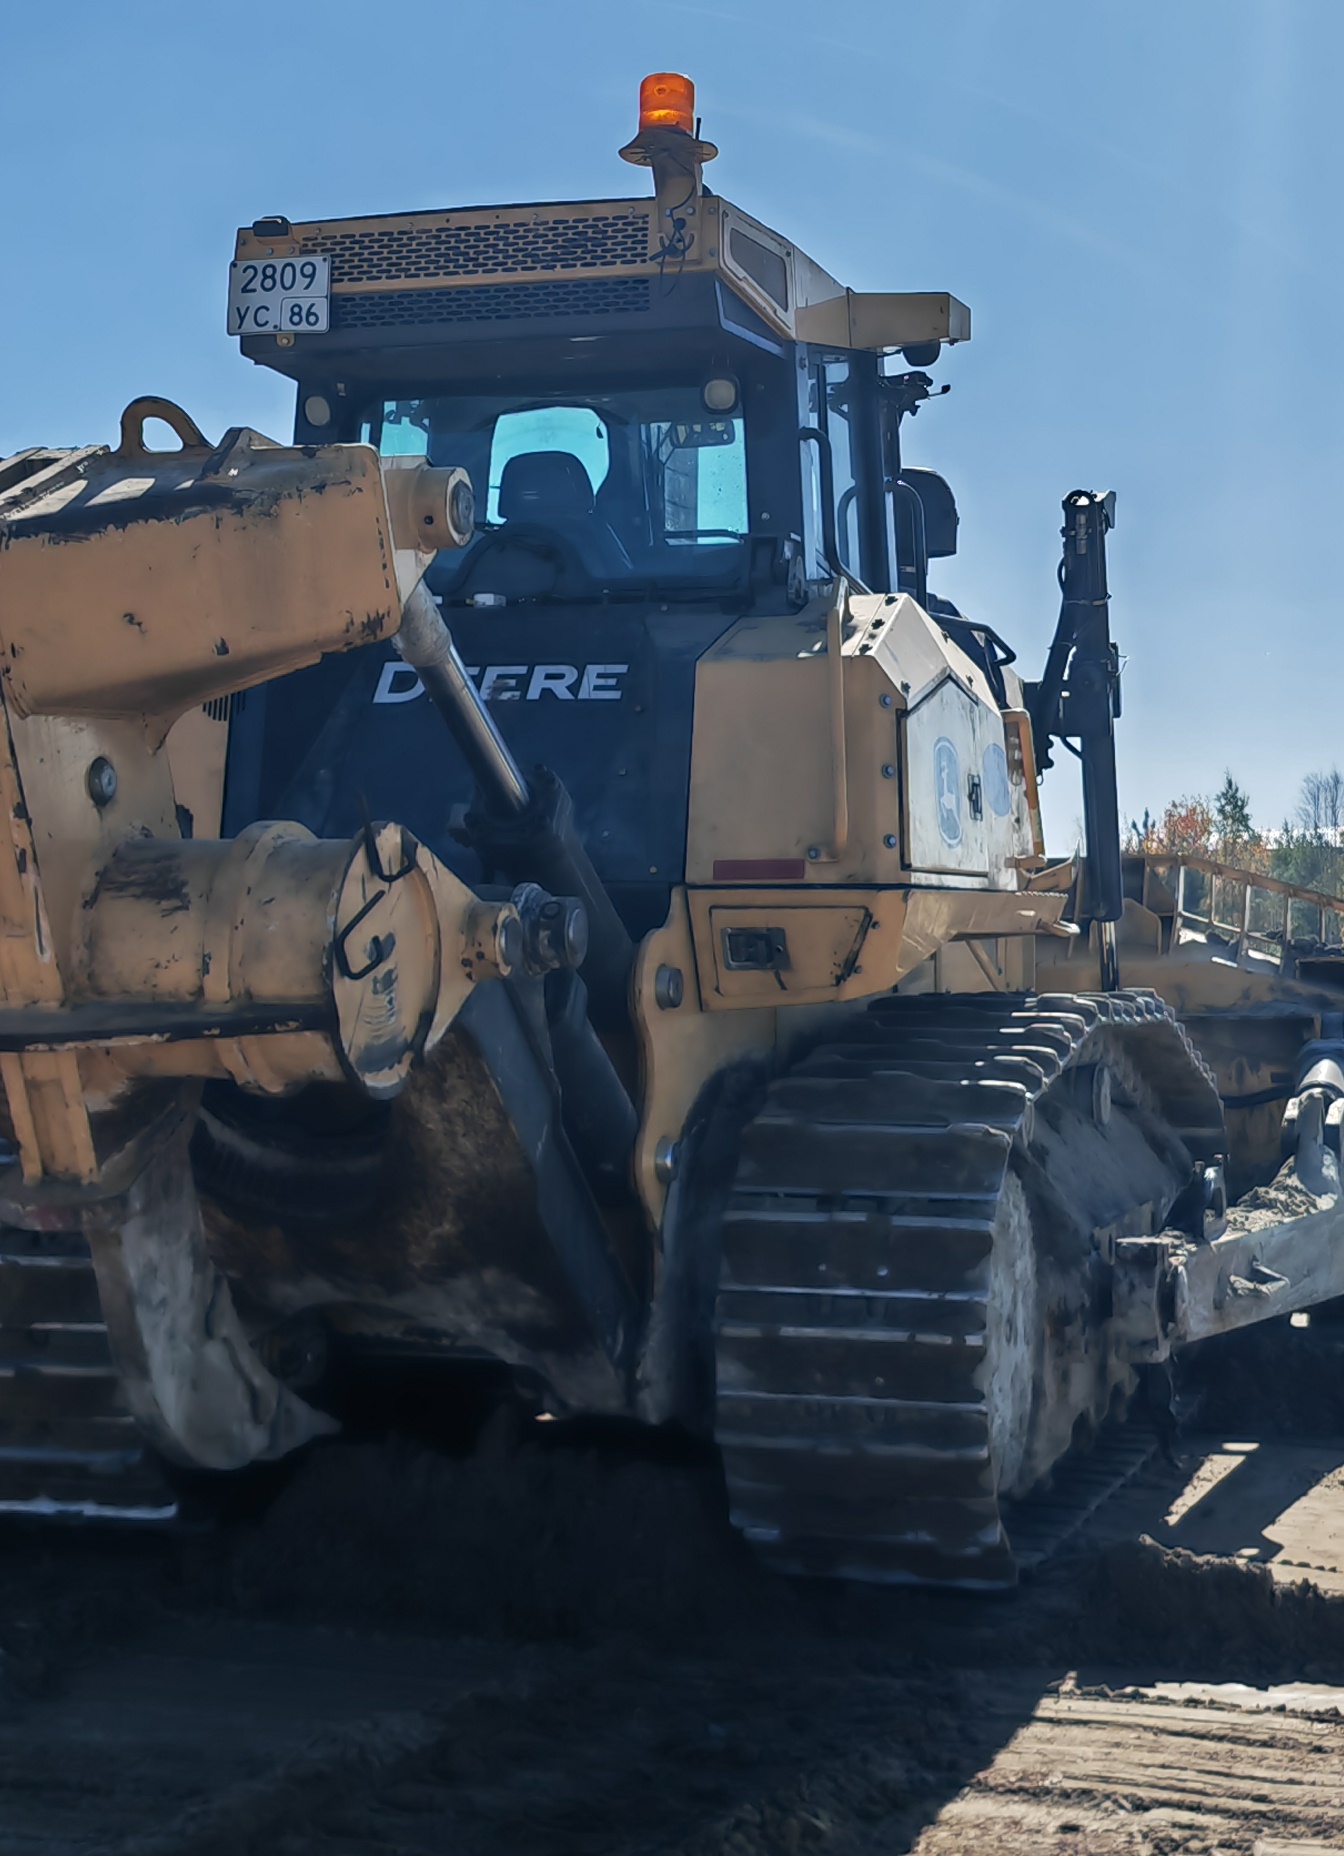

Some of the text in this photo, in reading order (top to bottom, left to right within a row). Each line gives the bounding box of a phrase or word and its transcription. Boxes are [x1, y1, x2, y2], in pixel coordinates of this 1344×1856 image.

[240, 261, 317, 294] 2809
[236, 303, 320, 330] УС 86
[372, 661, 629, 704] DERE
